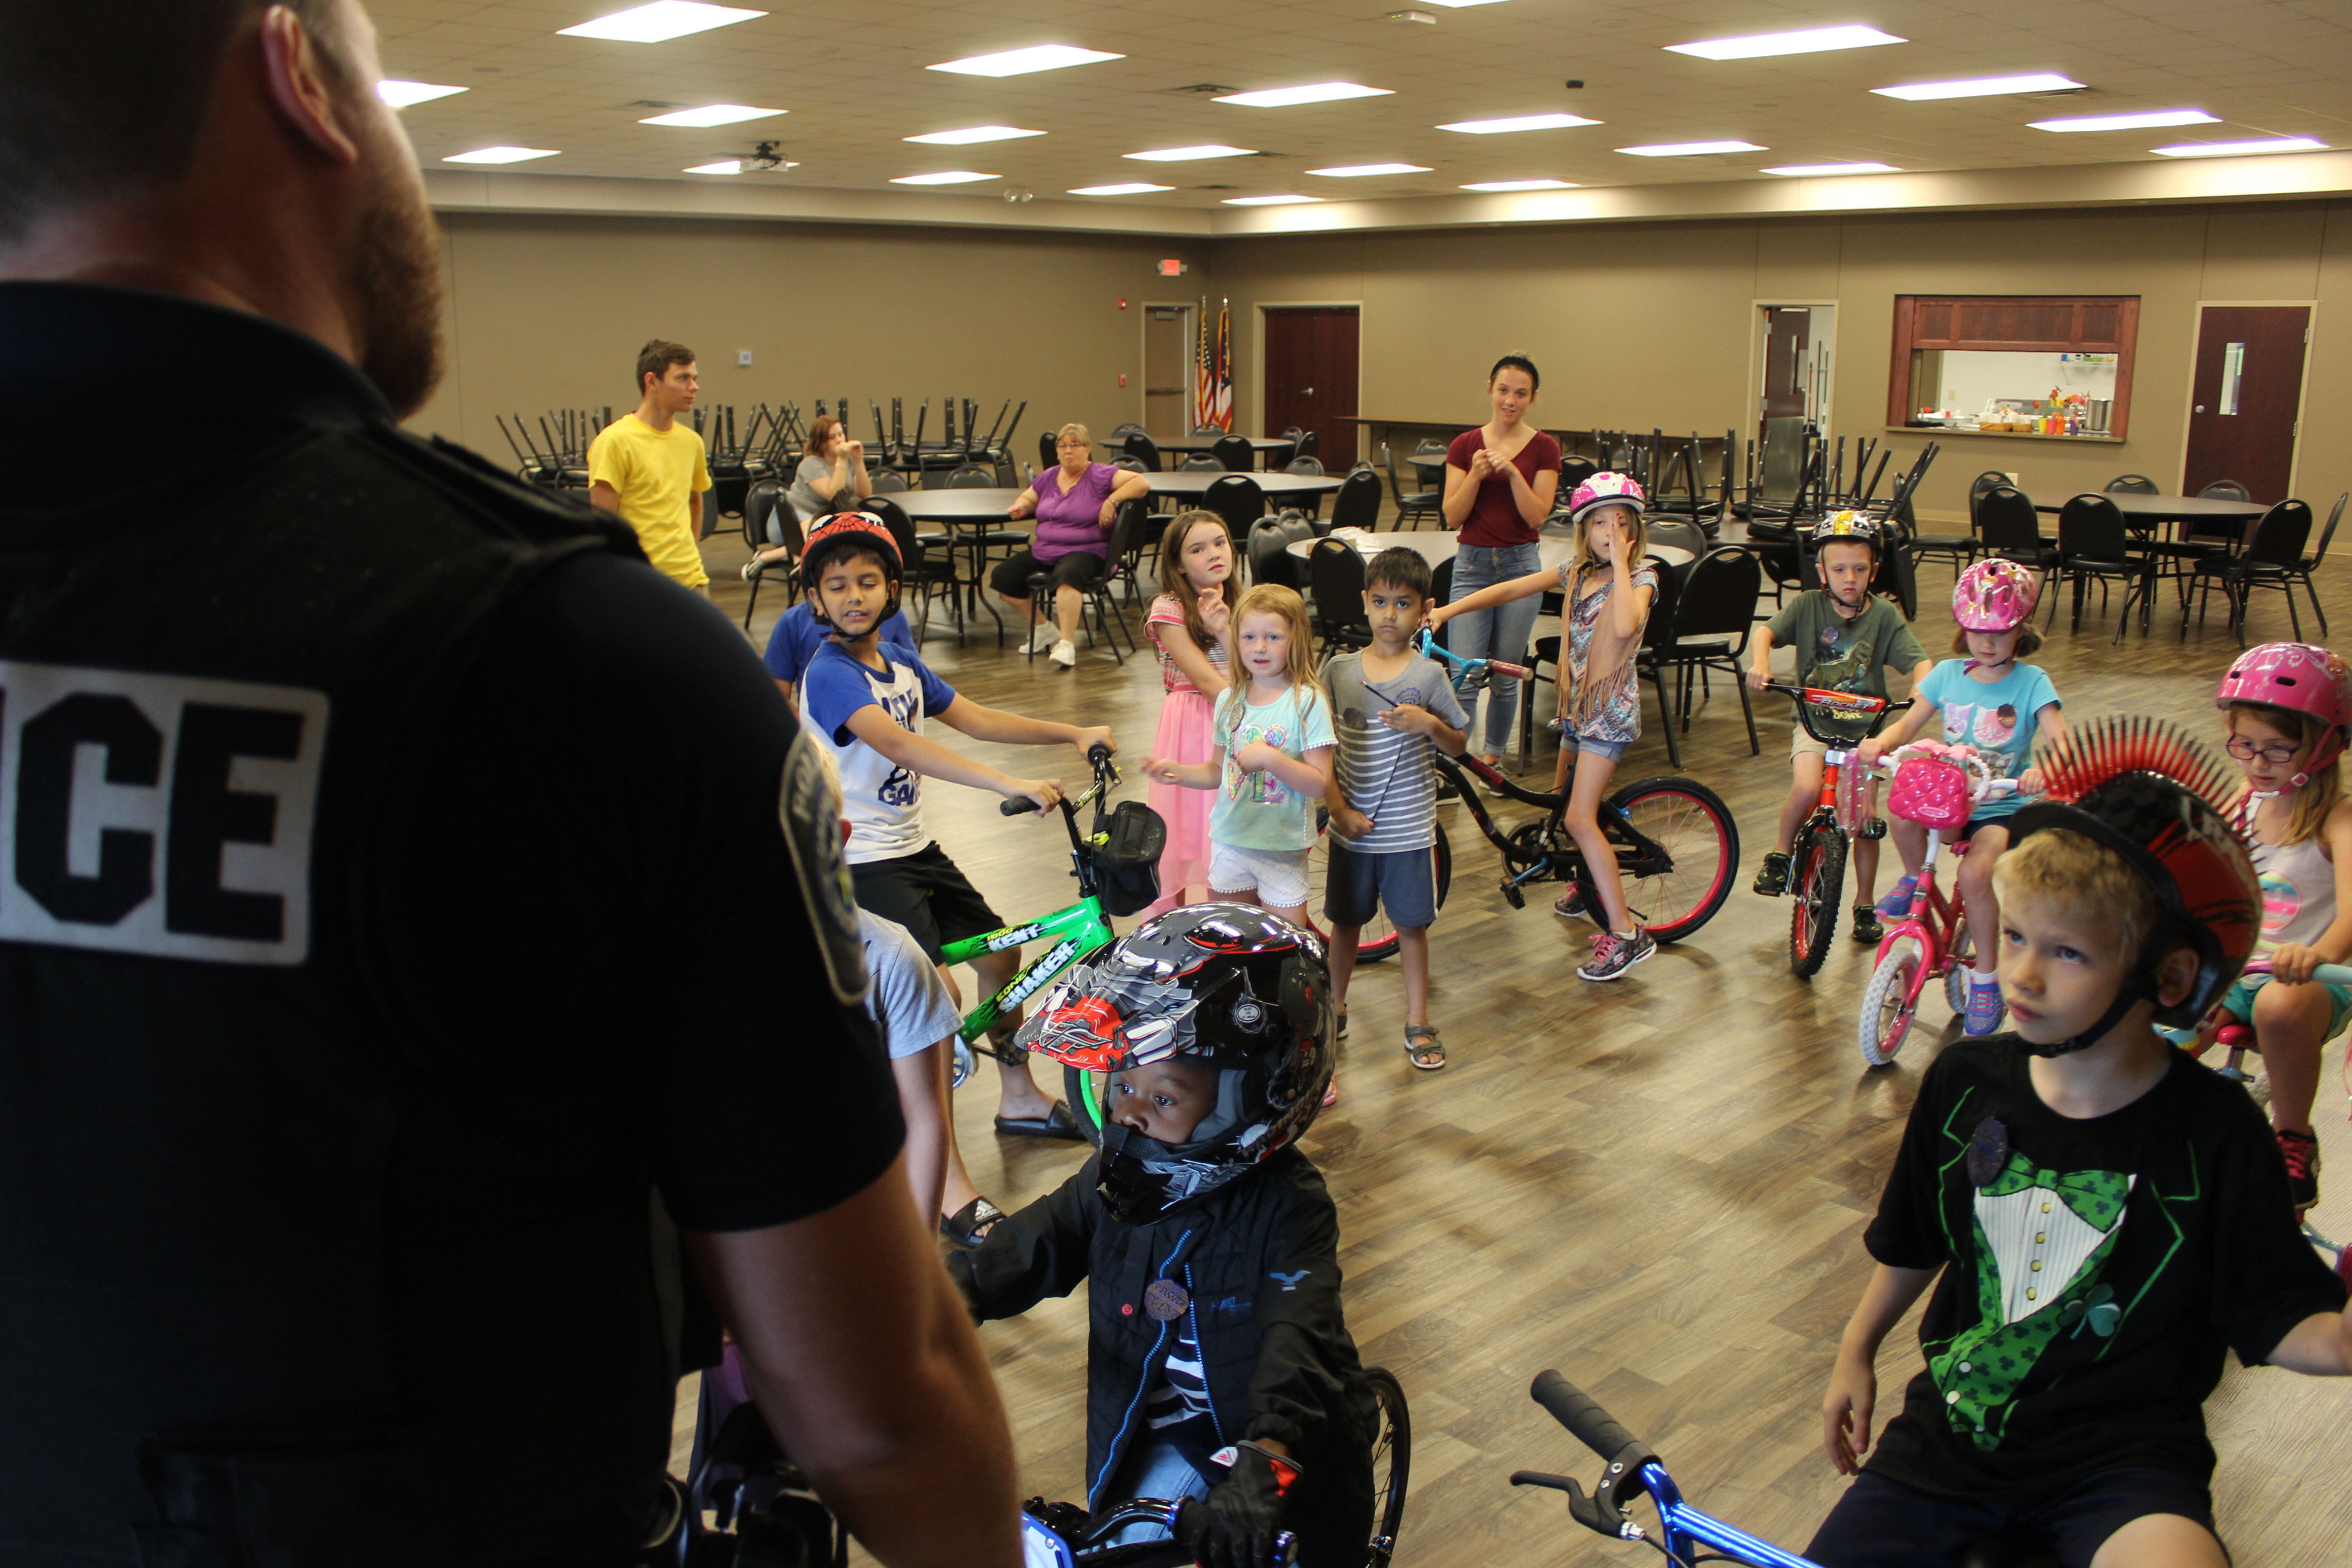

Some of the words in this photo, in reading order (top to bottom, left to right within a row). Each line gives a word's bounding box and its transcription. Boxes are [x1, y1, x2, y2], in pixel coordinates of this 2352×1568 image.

[1819, 698, 1870, 710] ROCKET
[0, 686, 305, 944] CE
[988, 923, 1039, 952] KENT
[999, 941, 1076, 1013] SHAKER
[1201, 1158, 1235, 1183] FLY
